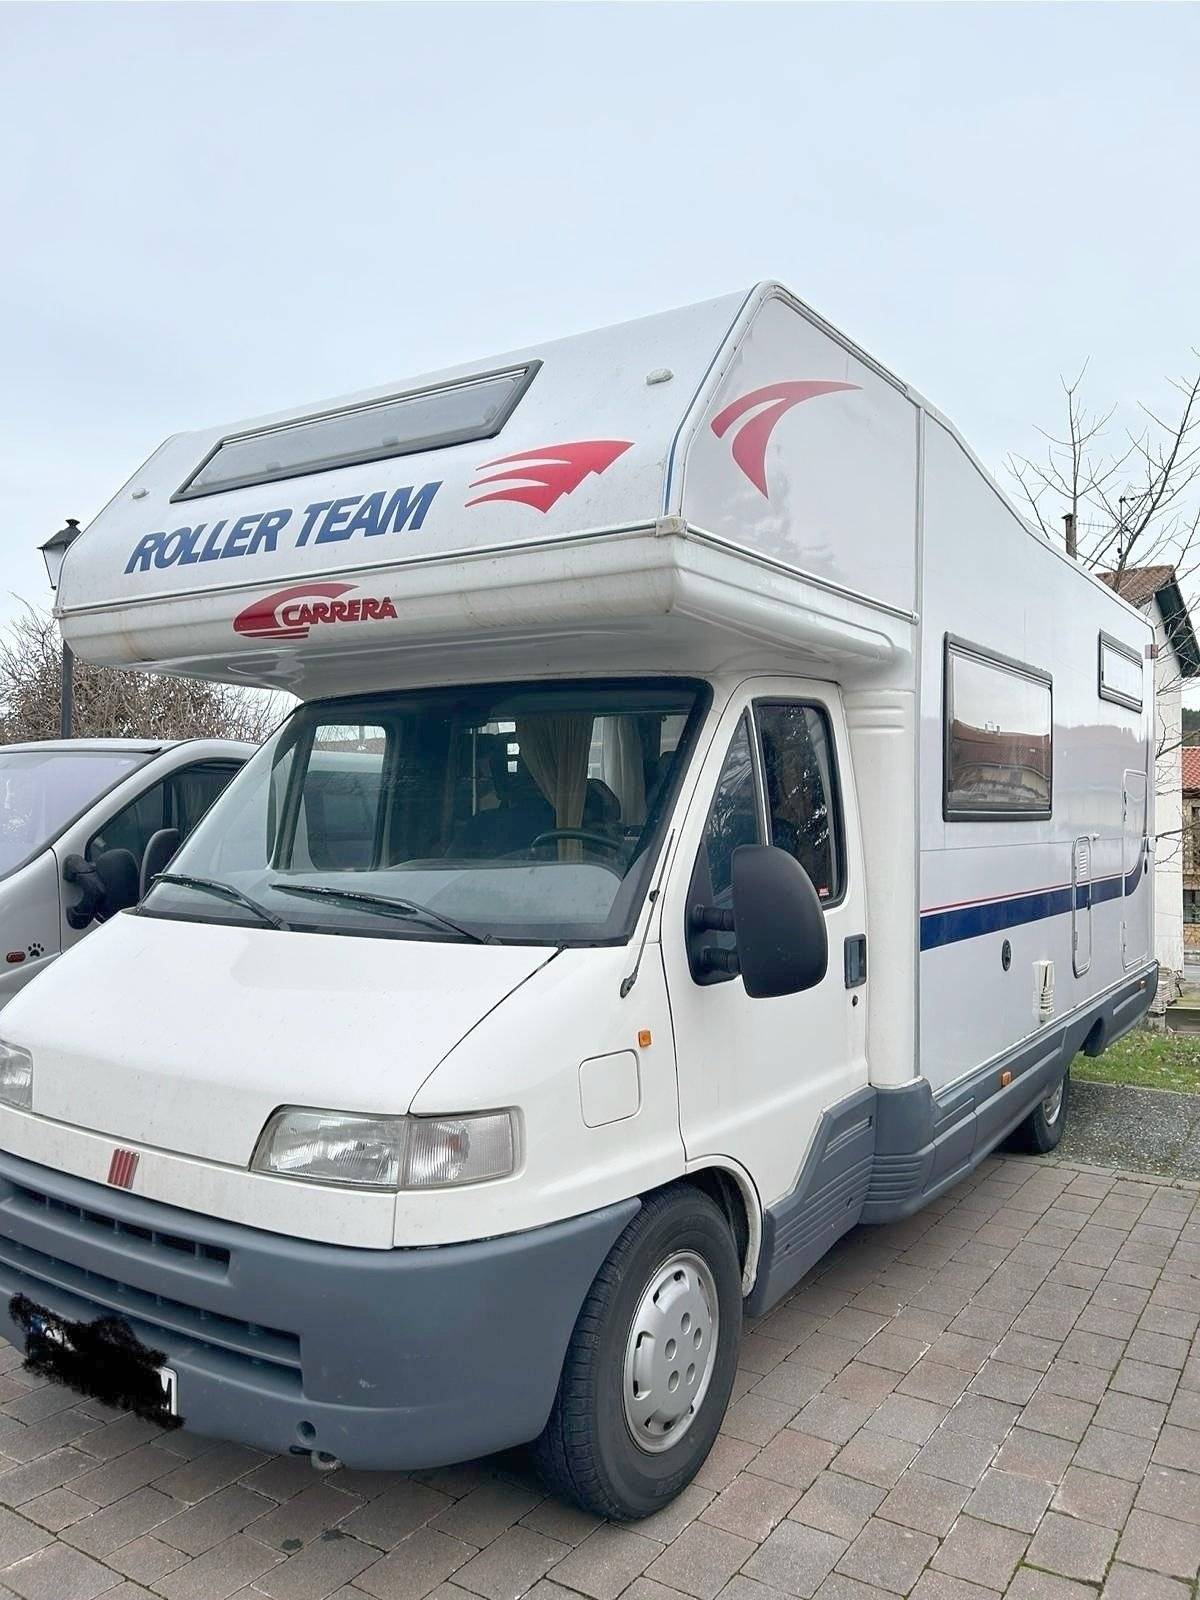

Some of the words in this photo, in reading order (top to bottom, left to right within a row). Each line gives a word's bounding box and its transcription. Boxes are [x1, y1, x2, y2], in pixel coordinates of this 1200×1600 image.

[124, 508, 293, 574] ROLLER
[295, 480, 444, 548] TEAM
[281, 596, 398, 627] CARRERA
